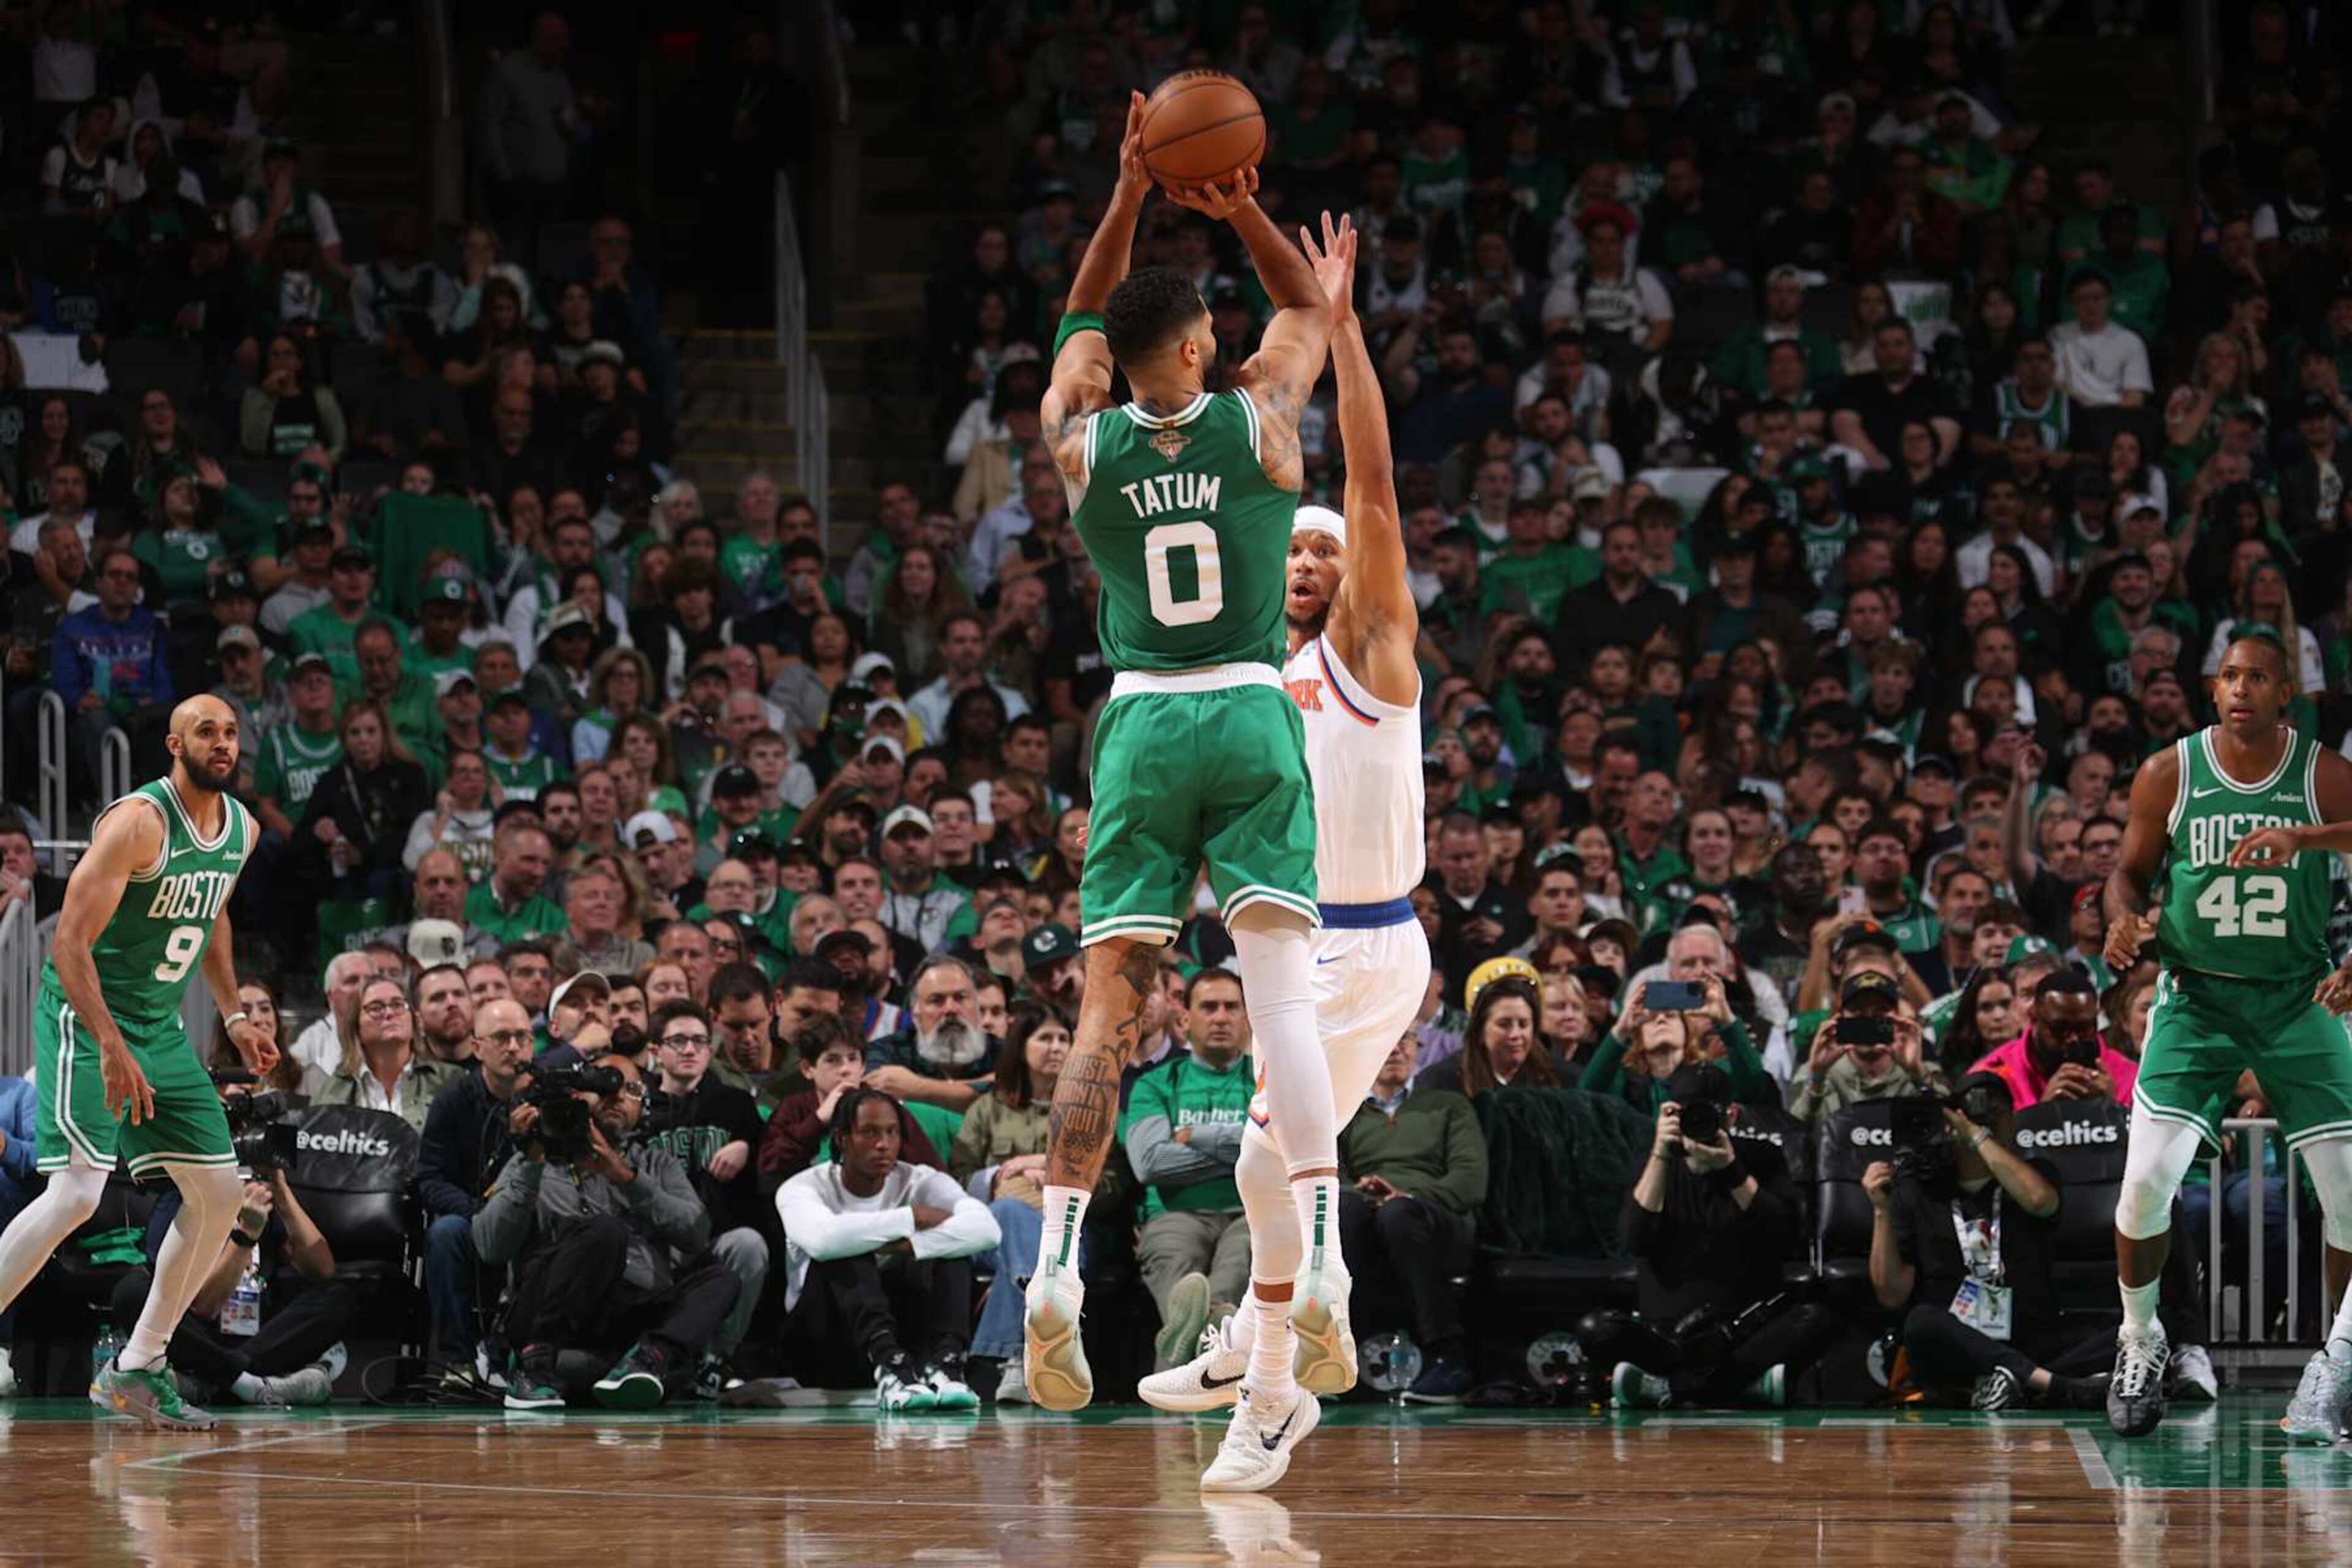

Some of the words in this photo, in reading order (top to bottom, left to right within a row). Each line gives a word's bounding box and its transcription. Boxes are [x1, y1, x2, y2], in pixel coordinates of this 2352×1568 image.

[1120, 473, 1221, 518] TATUM
[1145, 521, 1223, 627] 0
[147, 870, 236, 919] BOSTO
[2195, 875, 2287, 938] 42
[154, 925, 205, 983] 9
[1065, 1106, 1101, 1134] QUIT
[2016, 1121, 2118, 1148] @celtics
